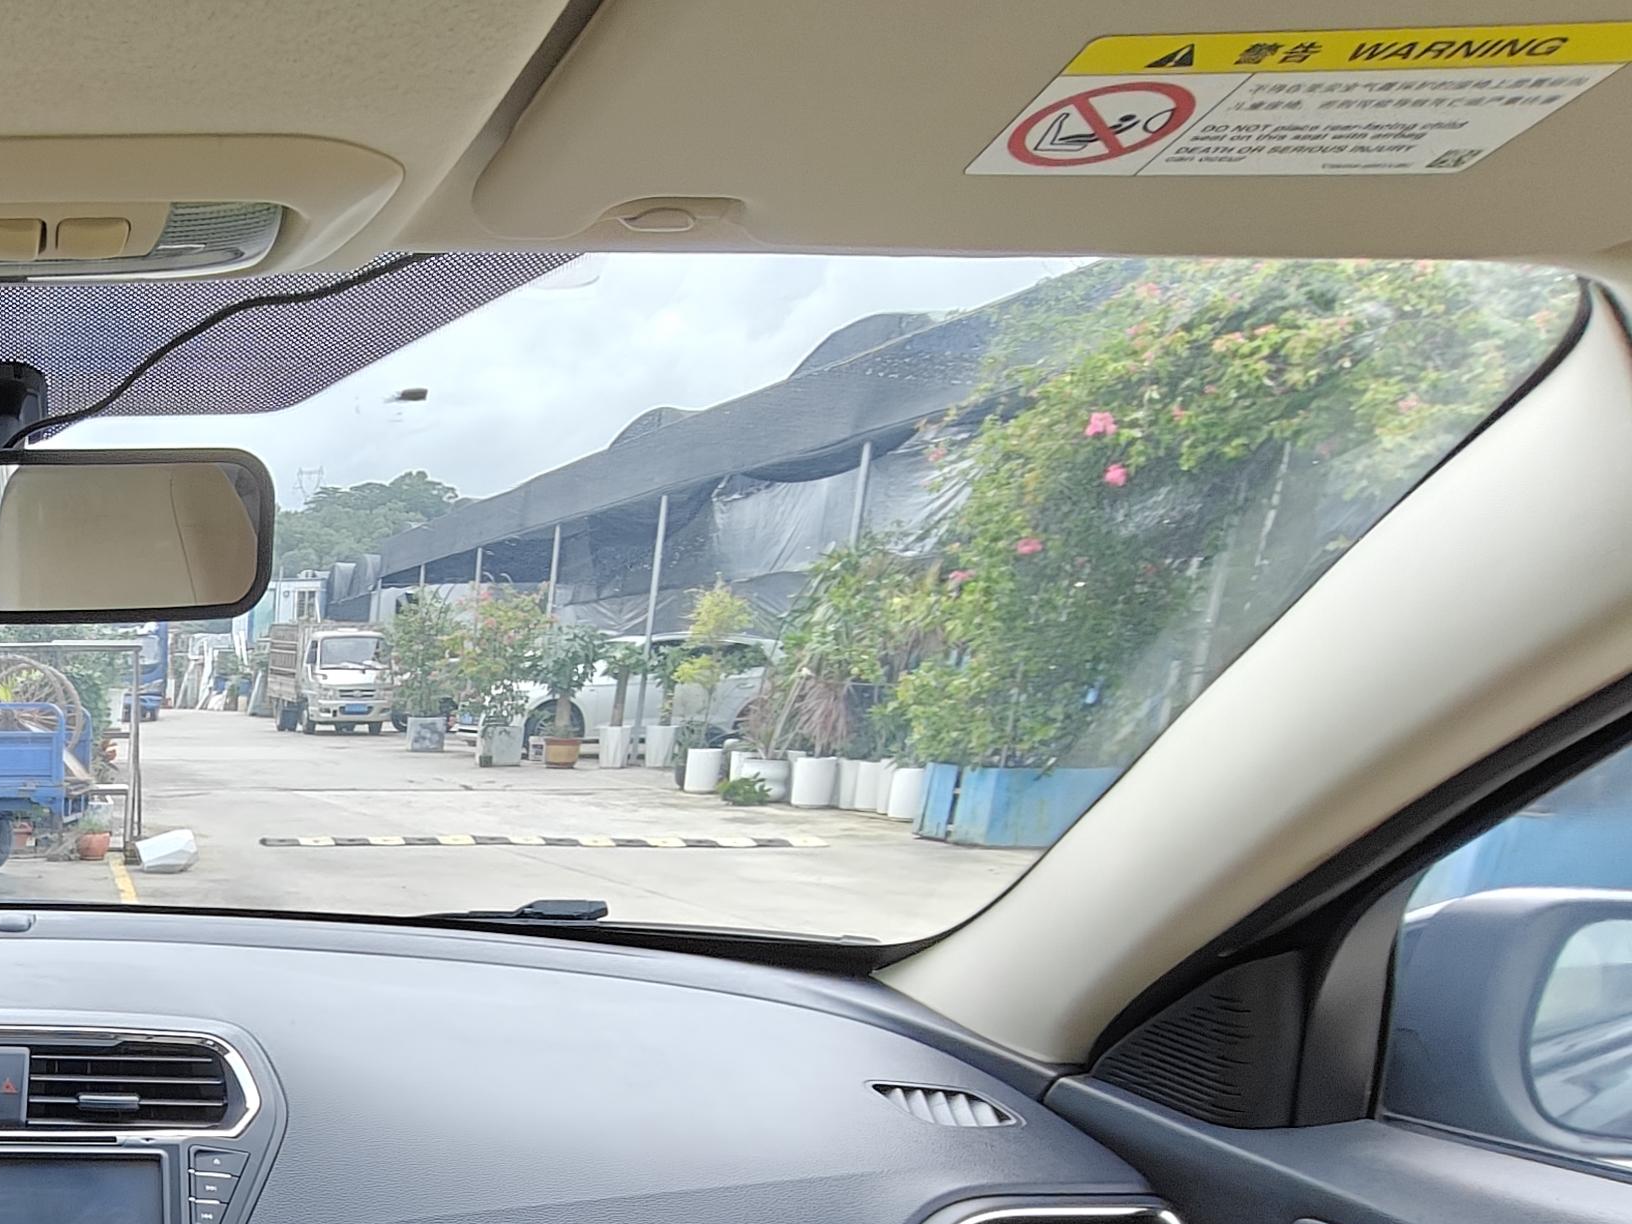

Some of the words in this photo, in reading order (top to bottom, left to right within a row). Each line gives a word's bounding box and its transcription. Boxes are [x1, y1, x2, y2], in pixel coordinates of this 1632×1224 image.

[1233, 42, 1323, 65] 警告
[1348, 37, 1569, 61] WARNING
[1201, 124, 1230, 133] DO
[1230, 124, 1272, 133] NOT
[1230, 133, 1251, 141] on
[1255, 132, 1288, 141] this
[1174, 145, 1235, 155] DEATH
[1236, 145, 1267, 154] OR
[1266, 144, 1349, 154] SERIOUS
